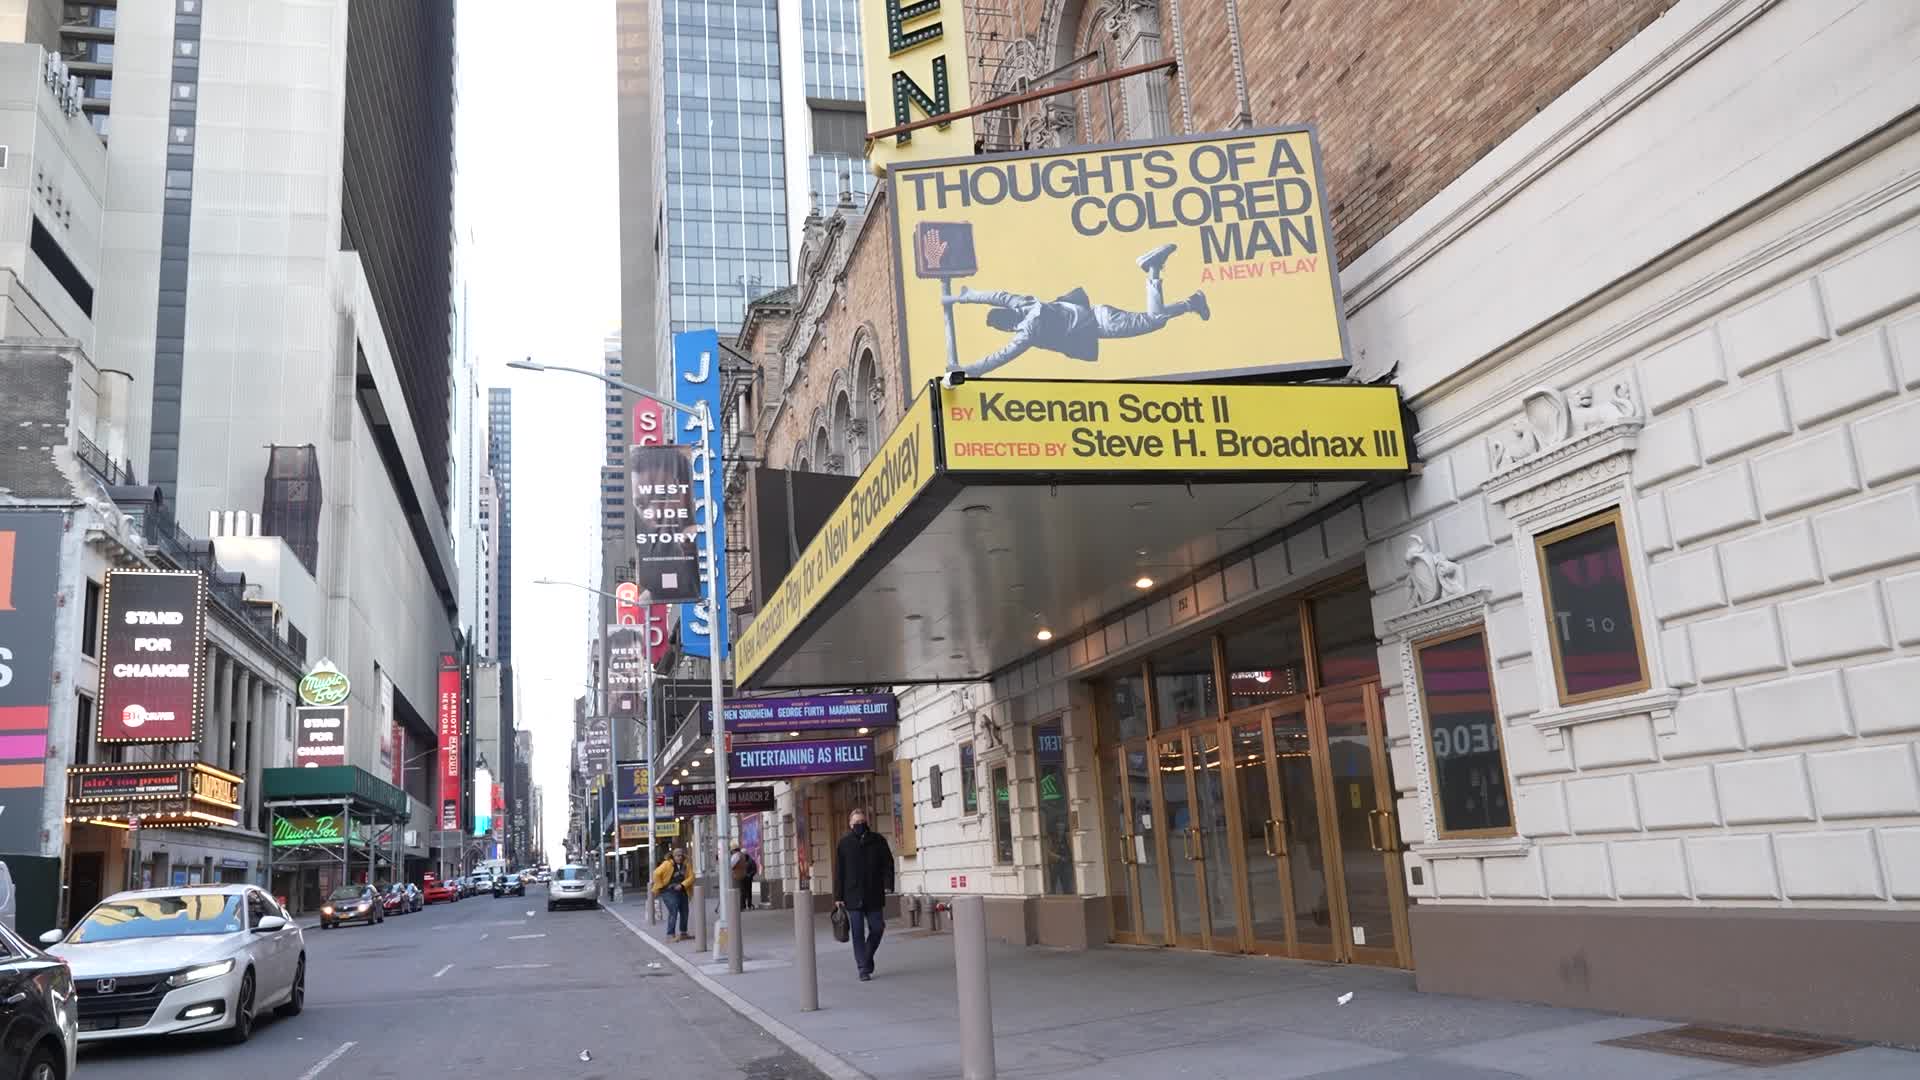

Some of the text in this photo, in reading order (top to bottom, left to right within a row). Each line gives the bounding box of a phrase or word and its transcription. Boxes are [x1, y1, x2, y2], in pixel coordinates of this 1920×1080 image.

[902, 138, 1306, 211] THOUGHTS OF A
[1071, 177, 1312, 237] COLORED
[1200, 216, 1318, 264] MAN
[1200, 257, 1318, 284] A NEW PLAY
[951, 392, 1230, 423] BY Keenan Scott II
[955, 428, 1398, 458] DIRECTED BY Steve H. Broadnax III
[638, 484, 689, 495] WEST
[643, 508, 688, 519] SIDE
[636, 533, 697, 544] STORY
[755, 601, 786, 655] American
[785, 569, 802, 623] Play
[802, 561, 817, 599] for
[816, 549, 824, 583] a
[824, 515, 849, 574] New
[850, 424, 921, 543] Broadway
[124, 611, 184, 625] STAND
[134, 637, 171, 652] FOR
[113, 664, 190, 678] CHANGE
[305, 672, 343, 691] Music
[609, 676, 643, 684] STORY
[313, 686, 345, 703] Box
[739, 708, 773, 720] SONDHEIM
[778, 706, 803, 718] GEORGE
[804, 705, 825, 717] FURTH
[829, 704, 862, 715] MARIANNE
[863, 703, 888, 714] ELLIOTT
[303, 718, 340, 728] STAND
[309, 731, 333, 742] FOR
[297, 745, 344, 756] CHANGE
[735, 745, 868, 767] "ENTERTAINING AS HELL!"
[139, 774, 178, 787] proud
[679, 793, 715, 806] PREVIEWS
[738, 791, 762, 802] MARCH
[764, 790, 770, 801] 2
[274, 815, 338, 840] Music Box
